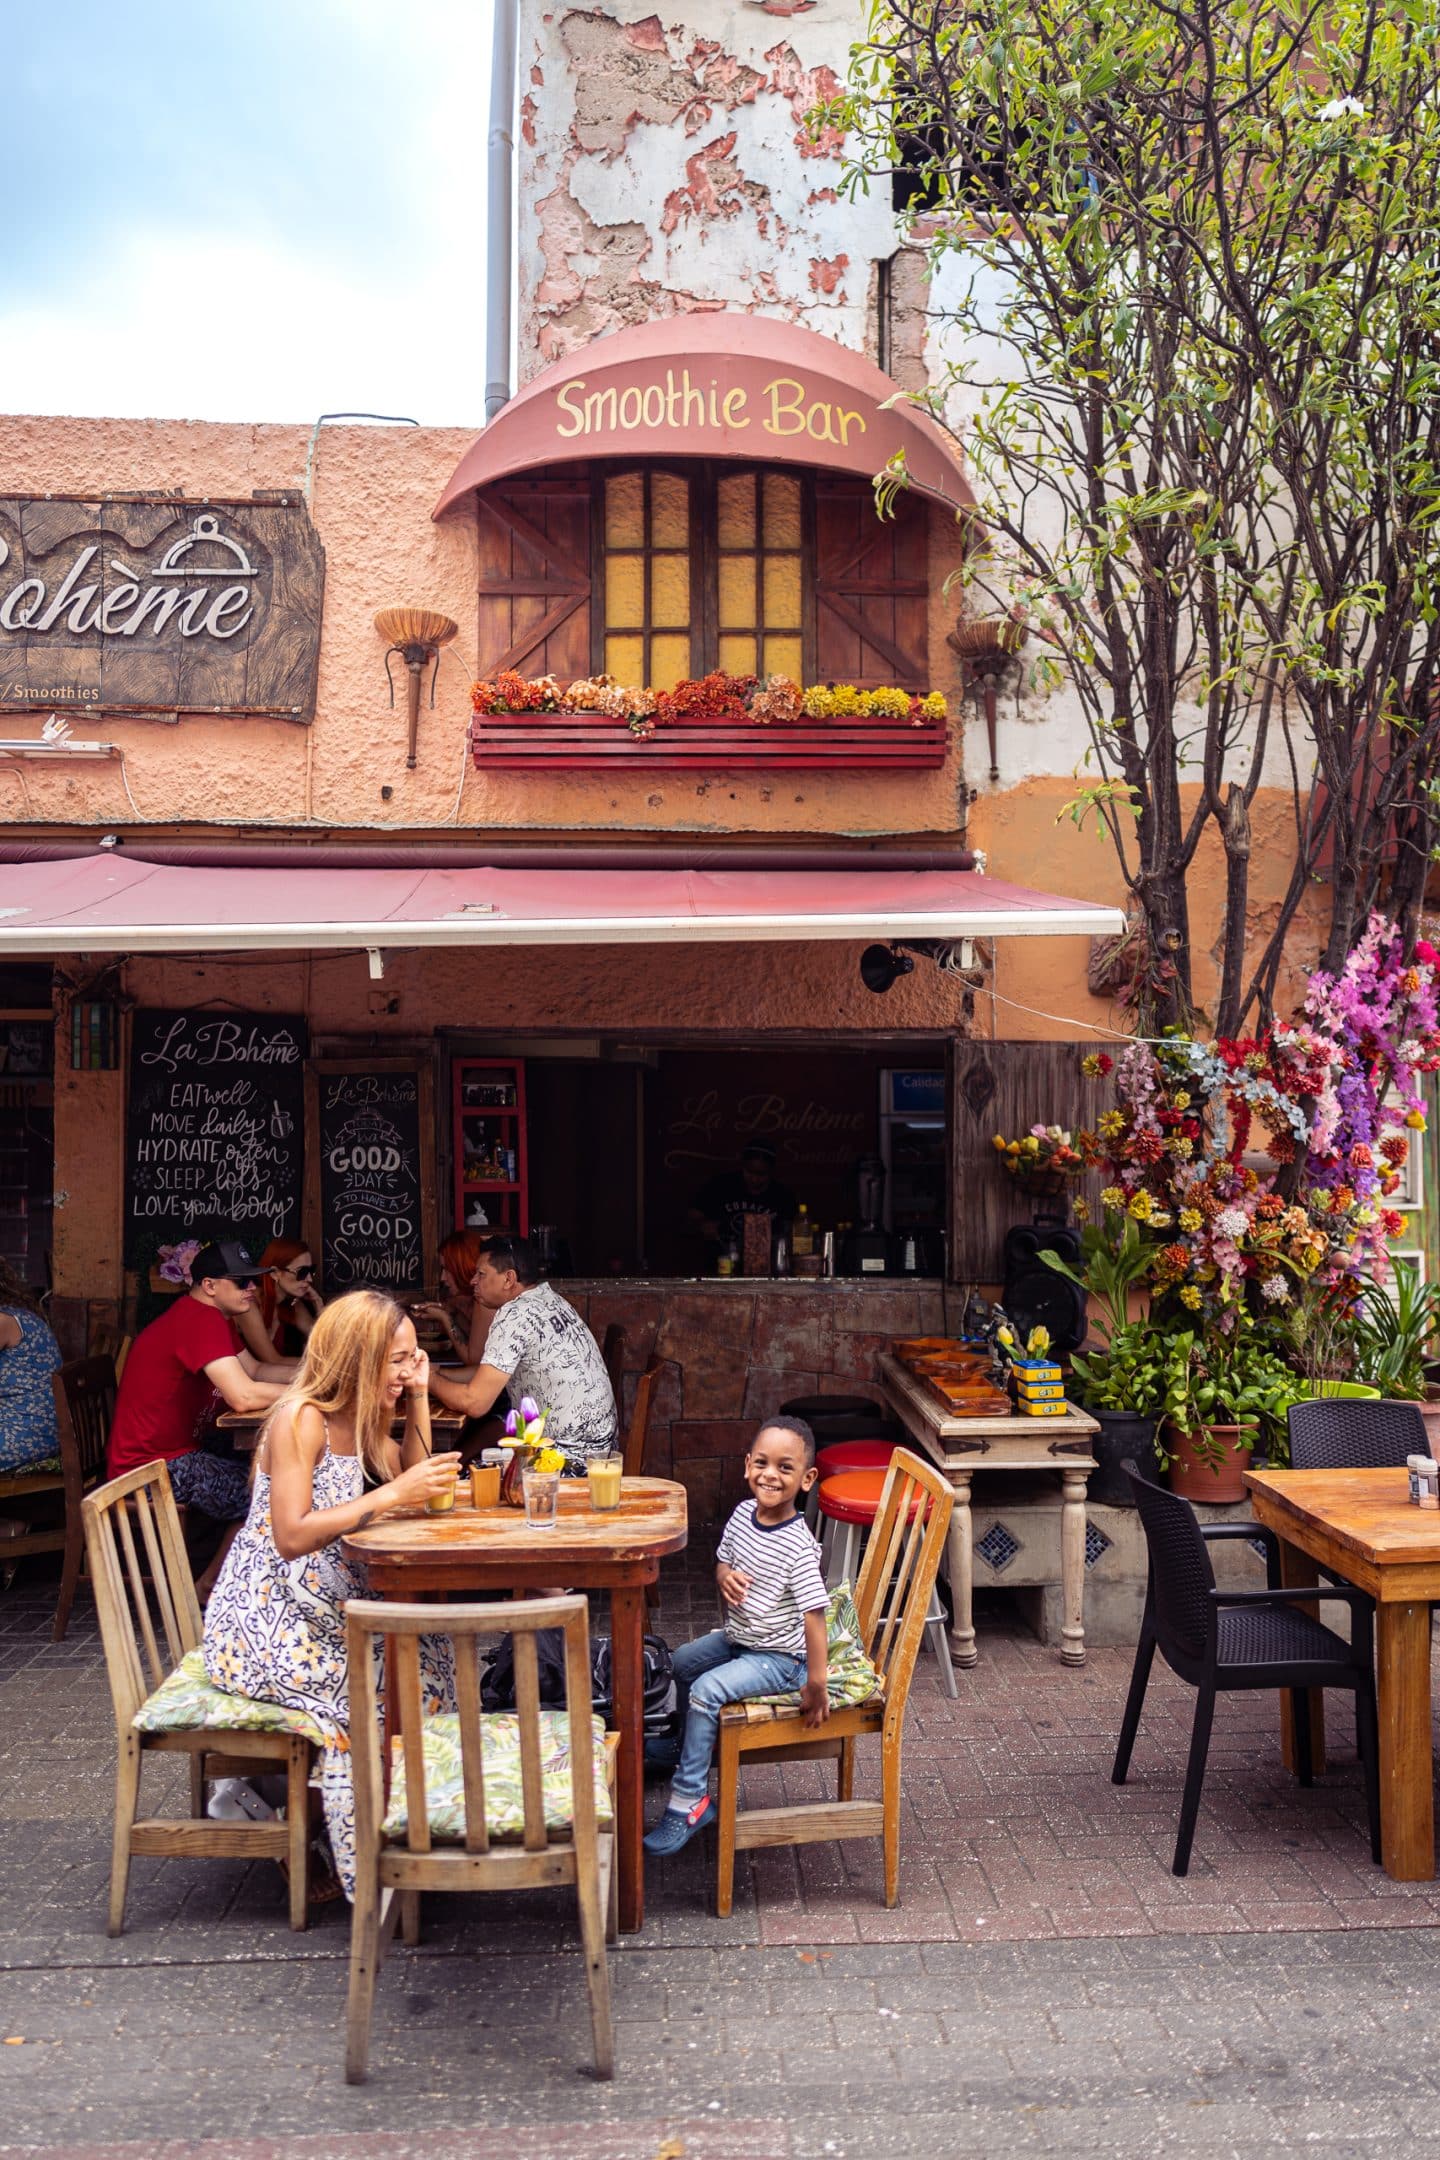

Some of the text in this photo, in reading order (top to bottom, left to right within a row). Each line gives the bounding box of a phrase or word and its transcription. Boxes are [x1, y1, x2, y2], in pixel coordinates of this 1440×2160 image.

[556, 369, 867, 446] Smoothie Bar
[0, 537, 253, 639] ohème
[141, 1017, 300, 1073] La Bohème
[170, 1079, 258, 1108] EAT well
[325, 1075, 357, 1110] La
[150, 1107, 266, 1145] MOVE daily
[137, 1137, 289, 1170] HYDRATE often
[329, 1146, 401, 1173] GOOD
[154, 1159, 271, 1192] SLEEP lots
[354, 1172, 384, 1188] DAY
[133, 1185, 294, 1238] LOVE your body
[343, 1192, 400, 1210] TO HAVE A
[340, 1213, 413, 1239] GOOD
[333, 1237, 419, 1283] Smoothie
